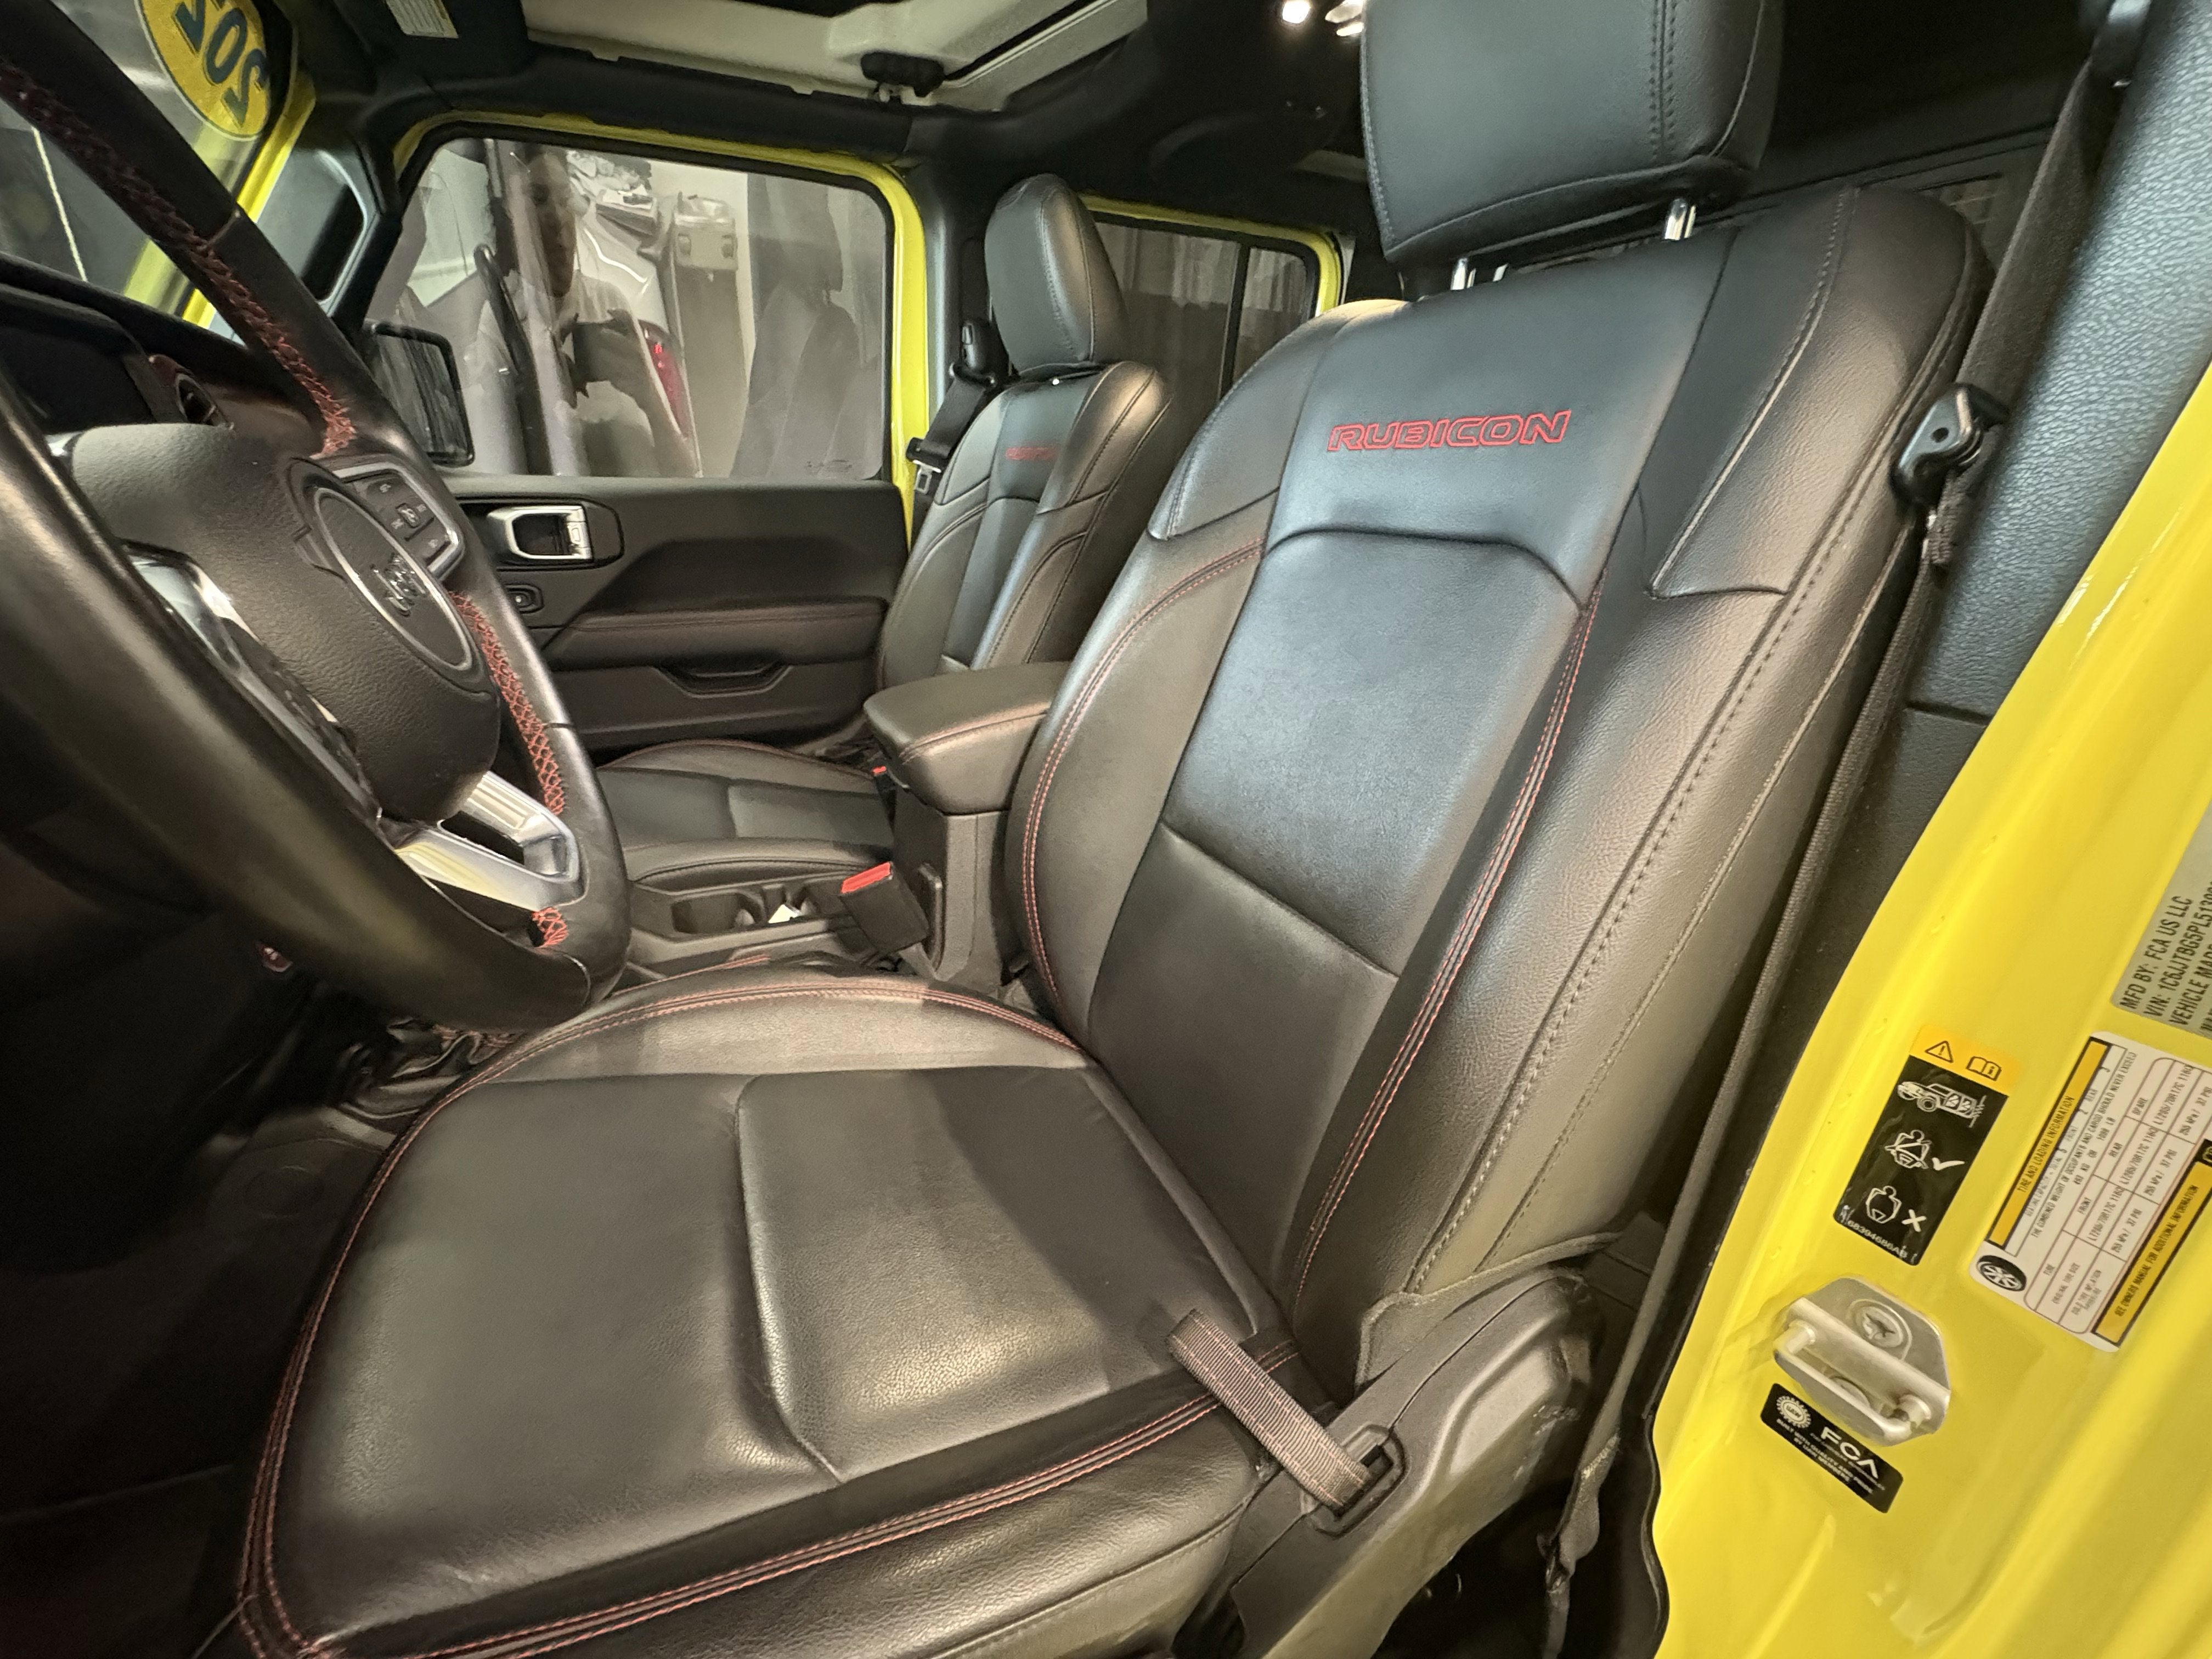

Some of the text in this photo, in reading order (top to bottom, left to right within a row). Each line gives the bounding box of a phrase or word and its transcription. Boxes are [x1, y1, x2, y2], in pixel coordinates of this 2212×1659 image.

[1327, 409, 1571, 451] RUBICON
[2119, 895, 2192, 1009] MFD BY: FCA US LLC
[2143, 994, 2170, 1017] VIN:
[2169, 979, 2209, 1025] VEHICLE
[2131, 1097, 2148, 1115] SPARE
[2016, 1096, 2074, 1192] TIRE AND LOADING INFORMATION
[2030, 1227, 2042, 1238] THE
[2036, 1201, 2055, 1228] COMBINED
[2050, 1182, 2065, 1201] WEIGHT
[2064, 1144, 2086, 1175] OCCUPANTS
[2081, 1132, 2092, 1144] AND
[2087, 1113, 2103, 1132] CARGO
[2097, 1092, 2115, 1114] SHOULD
[2109, 1073, 2125, 1092] NEVER
[2119, 1051, 2137, 1074] EXCEED
[2108, 1142, 2123, 1158] REAR
[2078, 1197, 2091, 1214] FRONT
[2145, 1251, 2158, 1264] FOR
[2170, 1184, 2198, 1222] INFORMATION
[1810, 1444, 1838, 1466] QUALITY
[1836, 1465, 1853, 1477] AND
[1816, 1426, 1878, 1478] FCA
